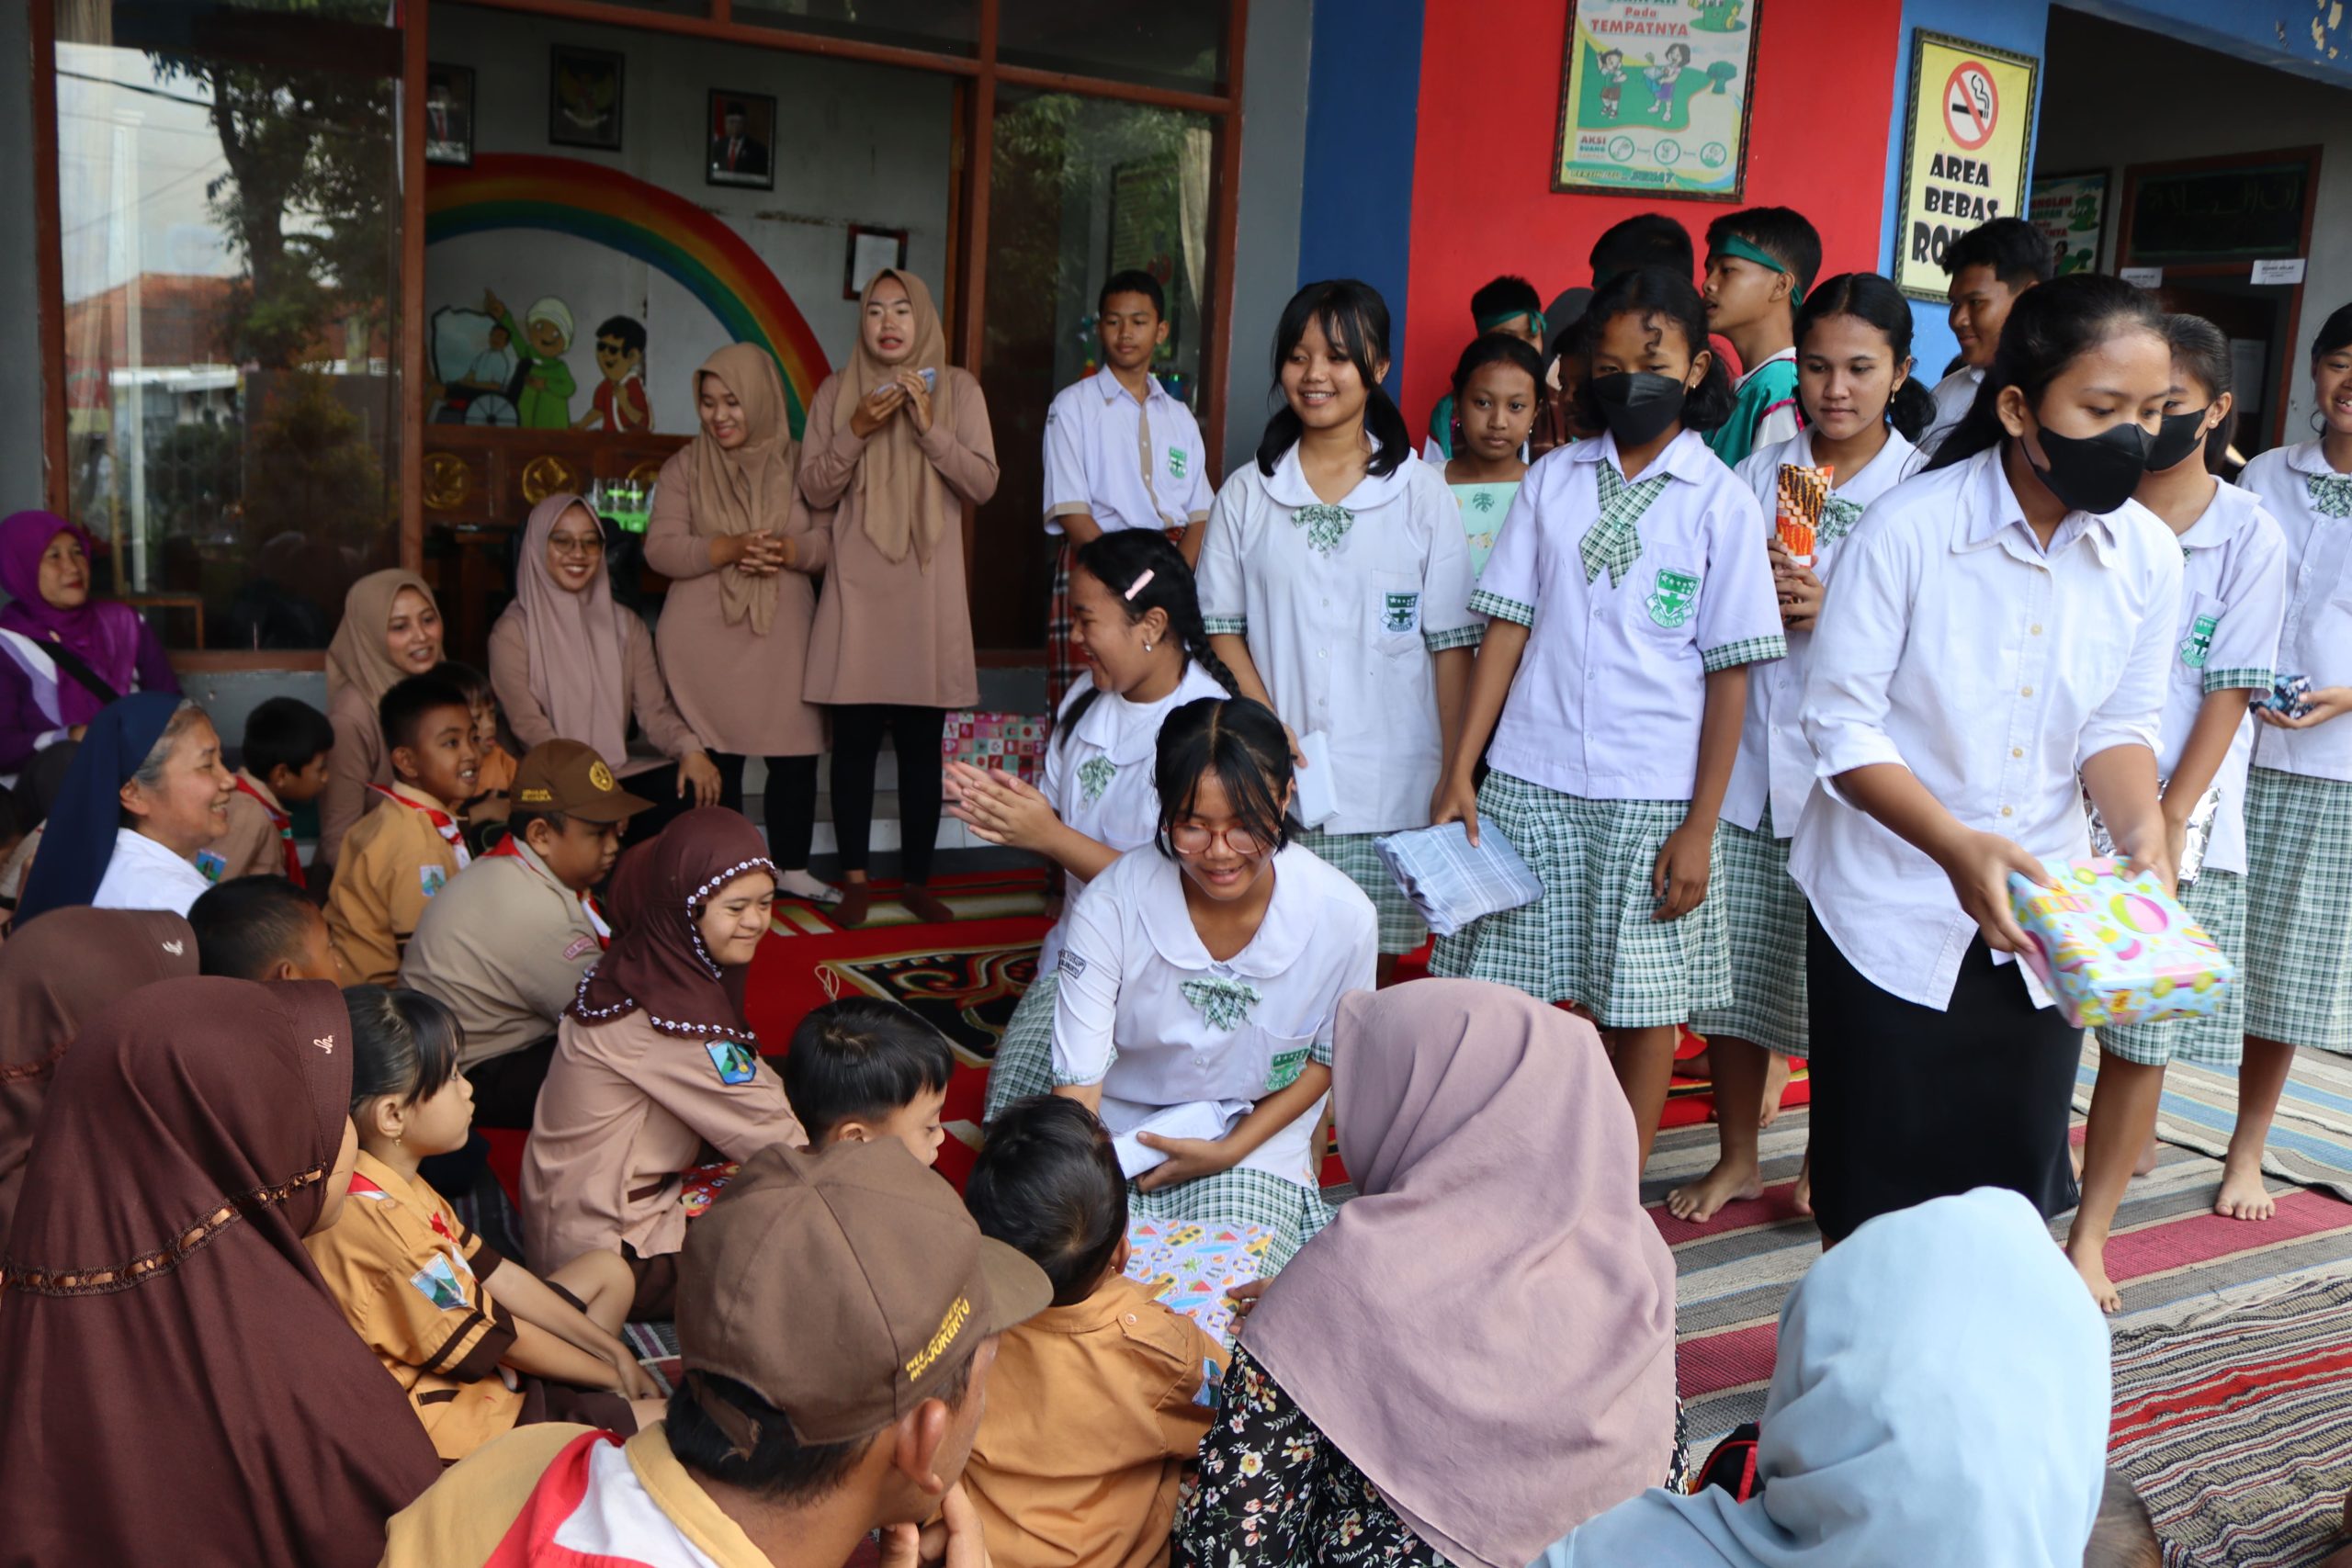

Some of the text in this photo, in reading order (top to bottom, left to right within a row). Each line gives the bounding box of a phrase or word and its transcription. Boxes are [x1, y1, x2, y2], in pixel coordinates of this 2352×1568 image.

[1625, 6, 1657, 18] Pada
[1590, 18, 1689, 37] TEMPATNYA
[1580, 136, 1606, 145] AKSI
[1929, 152, 1990, 187] AREA
[1925, 186, 1998, 222] BEBAS
[2031, 197, 2072, 208] ANGLAH
[2030, 209, 2063, 219] AMPAH
